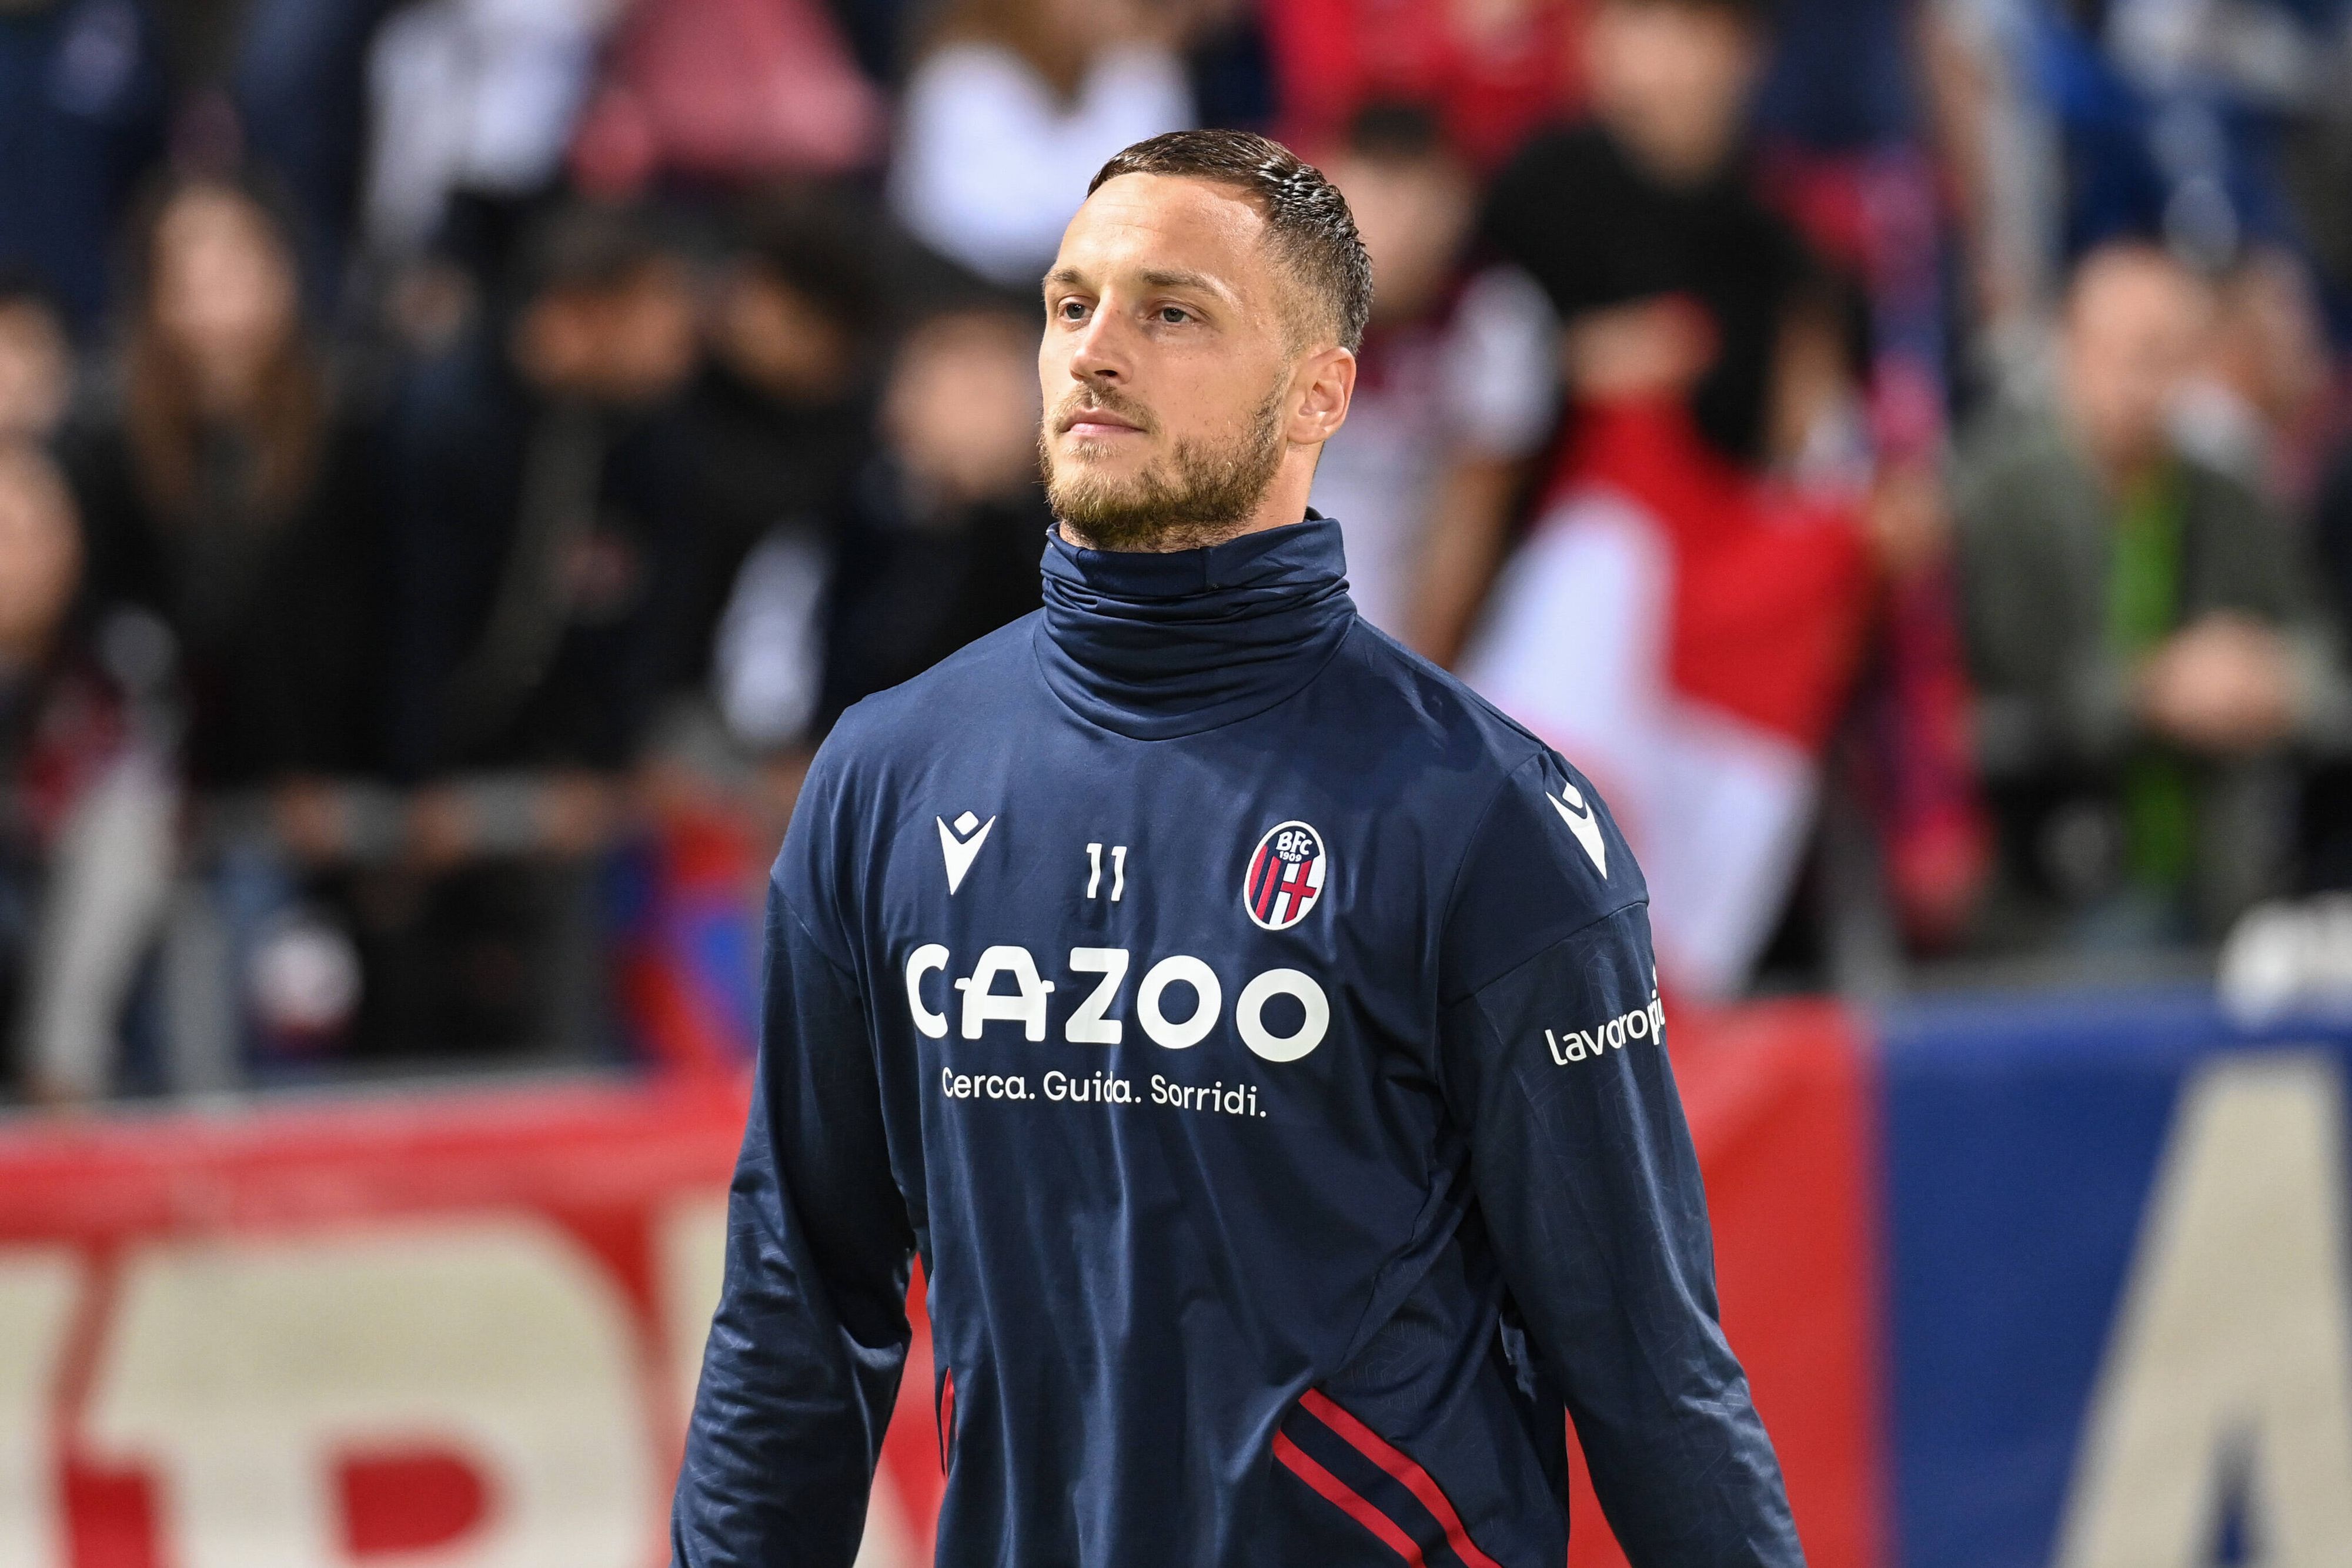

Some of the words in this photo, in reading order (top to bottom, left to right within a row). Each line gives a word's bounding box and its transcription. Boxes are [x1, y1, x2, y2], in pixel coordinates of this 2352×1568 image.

[1275, 830, 1313, 855] BFC
[1279, 850, 1302, 862] 1909
[1085, 842, 1128, 901] 11
[905, 943, 1331, 1062] CAZOO
[942, 1066, 1035, 1100] Cerca.
[1043, 1069, 1141, 1104] Guida.
[1151, 1074, 1267, 1118] Sorridi.
